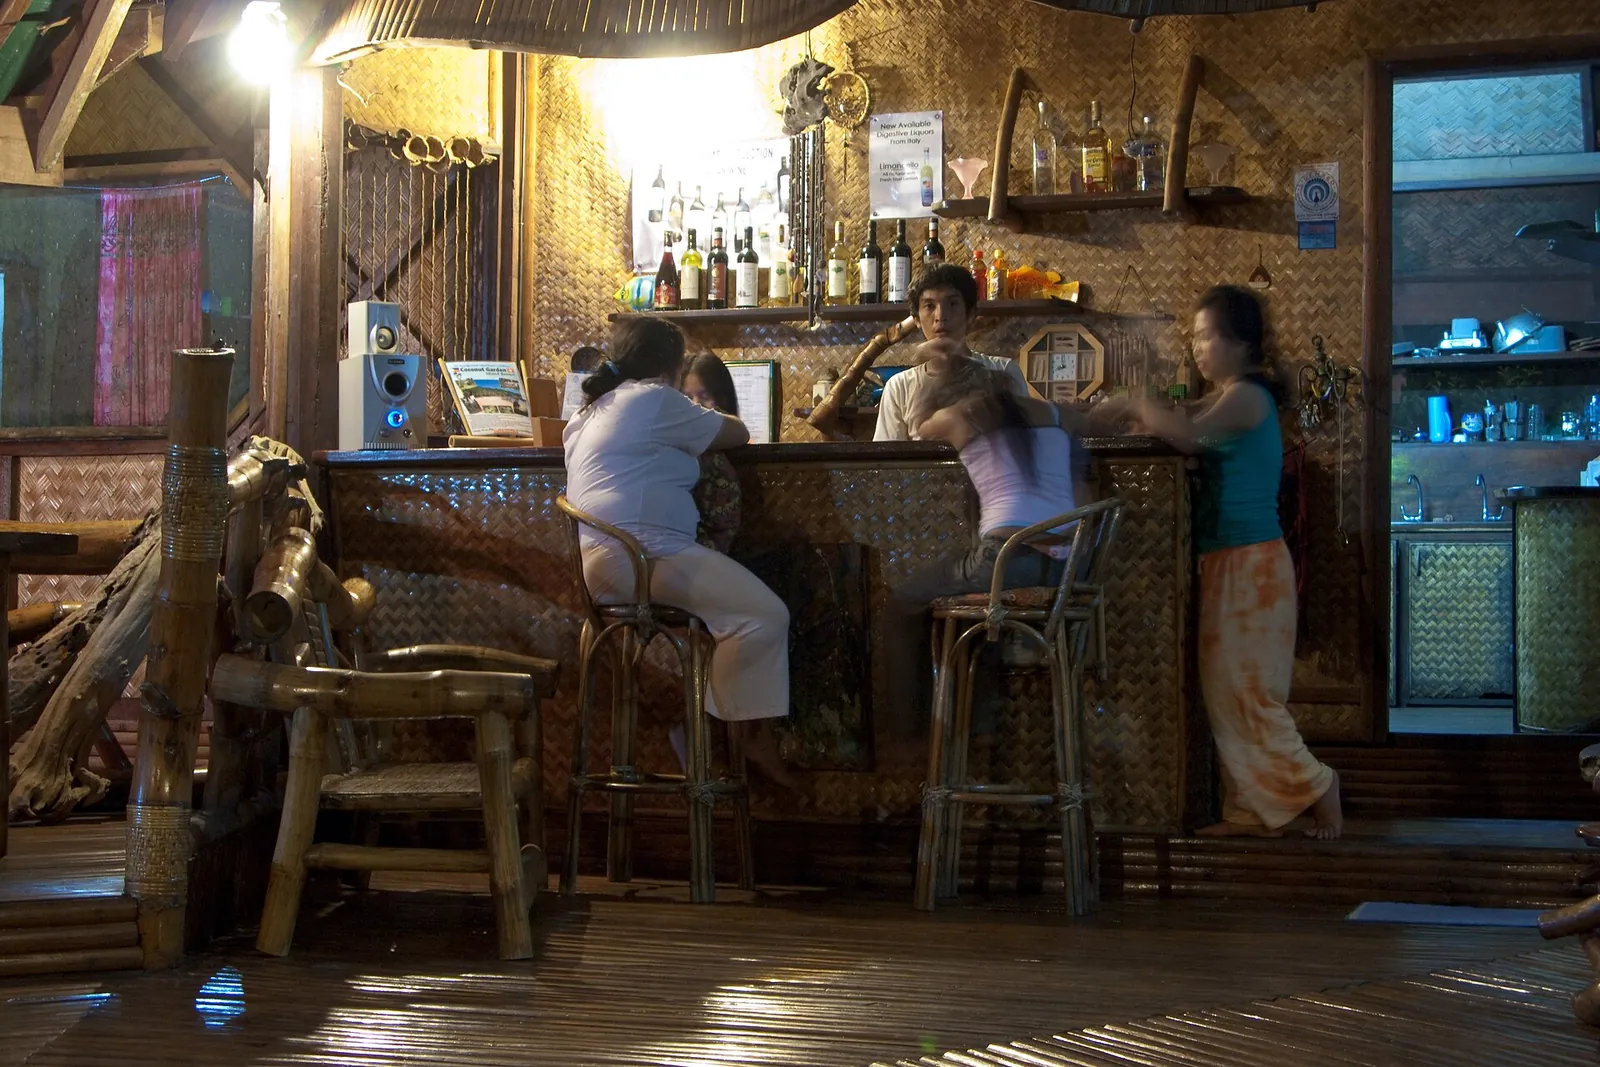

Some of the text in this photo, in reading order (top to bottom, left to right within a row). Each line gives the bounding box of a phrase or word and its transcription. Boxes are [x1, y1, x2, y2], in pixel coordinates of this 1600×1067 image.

[898, 120, 931, 129] Available
[876, 129, 935, 139] Digestive Liquors
[879, 162, 919, 170] Limoncllo
